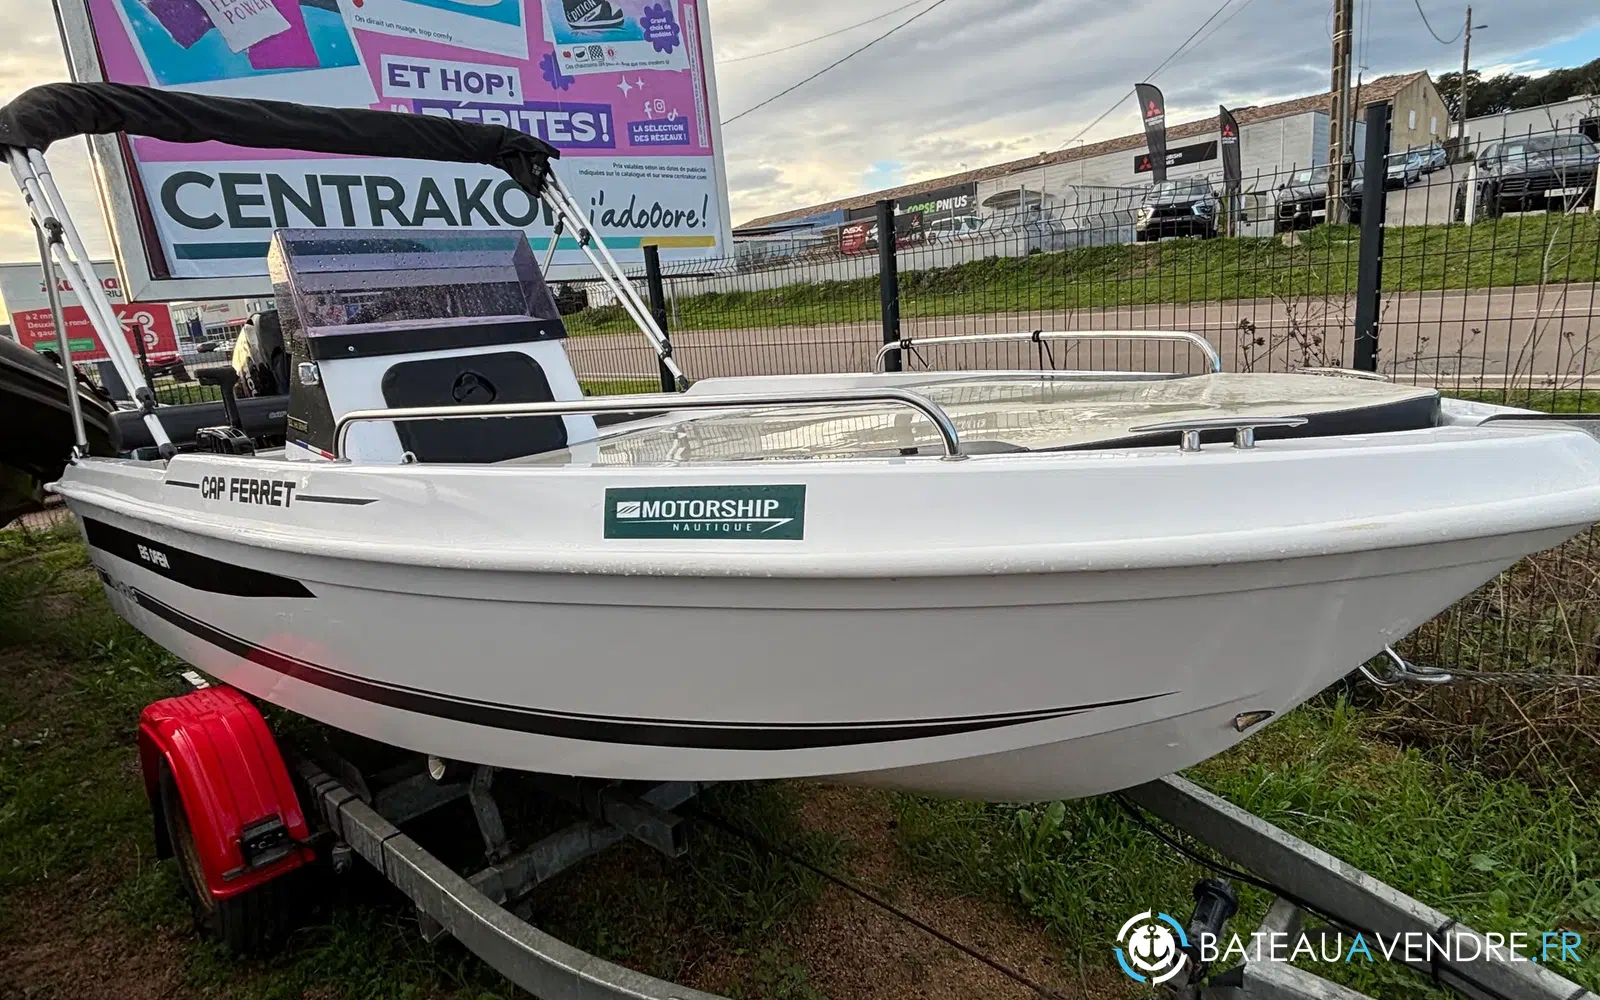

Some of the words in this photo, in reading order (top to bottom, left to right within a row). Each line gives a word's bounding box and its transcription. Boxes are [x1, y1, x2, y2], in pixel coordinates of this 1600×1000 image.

[355, 14, 365, 22] On
[366, 17, 384, 27] dirait
[396, 24, 417, 34] nuage,
[418, 28, 432, 37] trop
[387, 63, 430, 88] ET
[633, 125, 643, 133] LA
[635, 134, 650, 142] DES
[201, 476, 225, 500] CAP
[230, 478, 296, 508] FERRET
[642, 499, 779, 518] MOTORSHIP
[672, 523, 752, 532] NAUTIQUE
